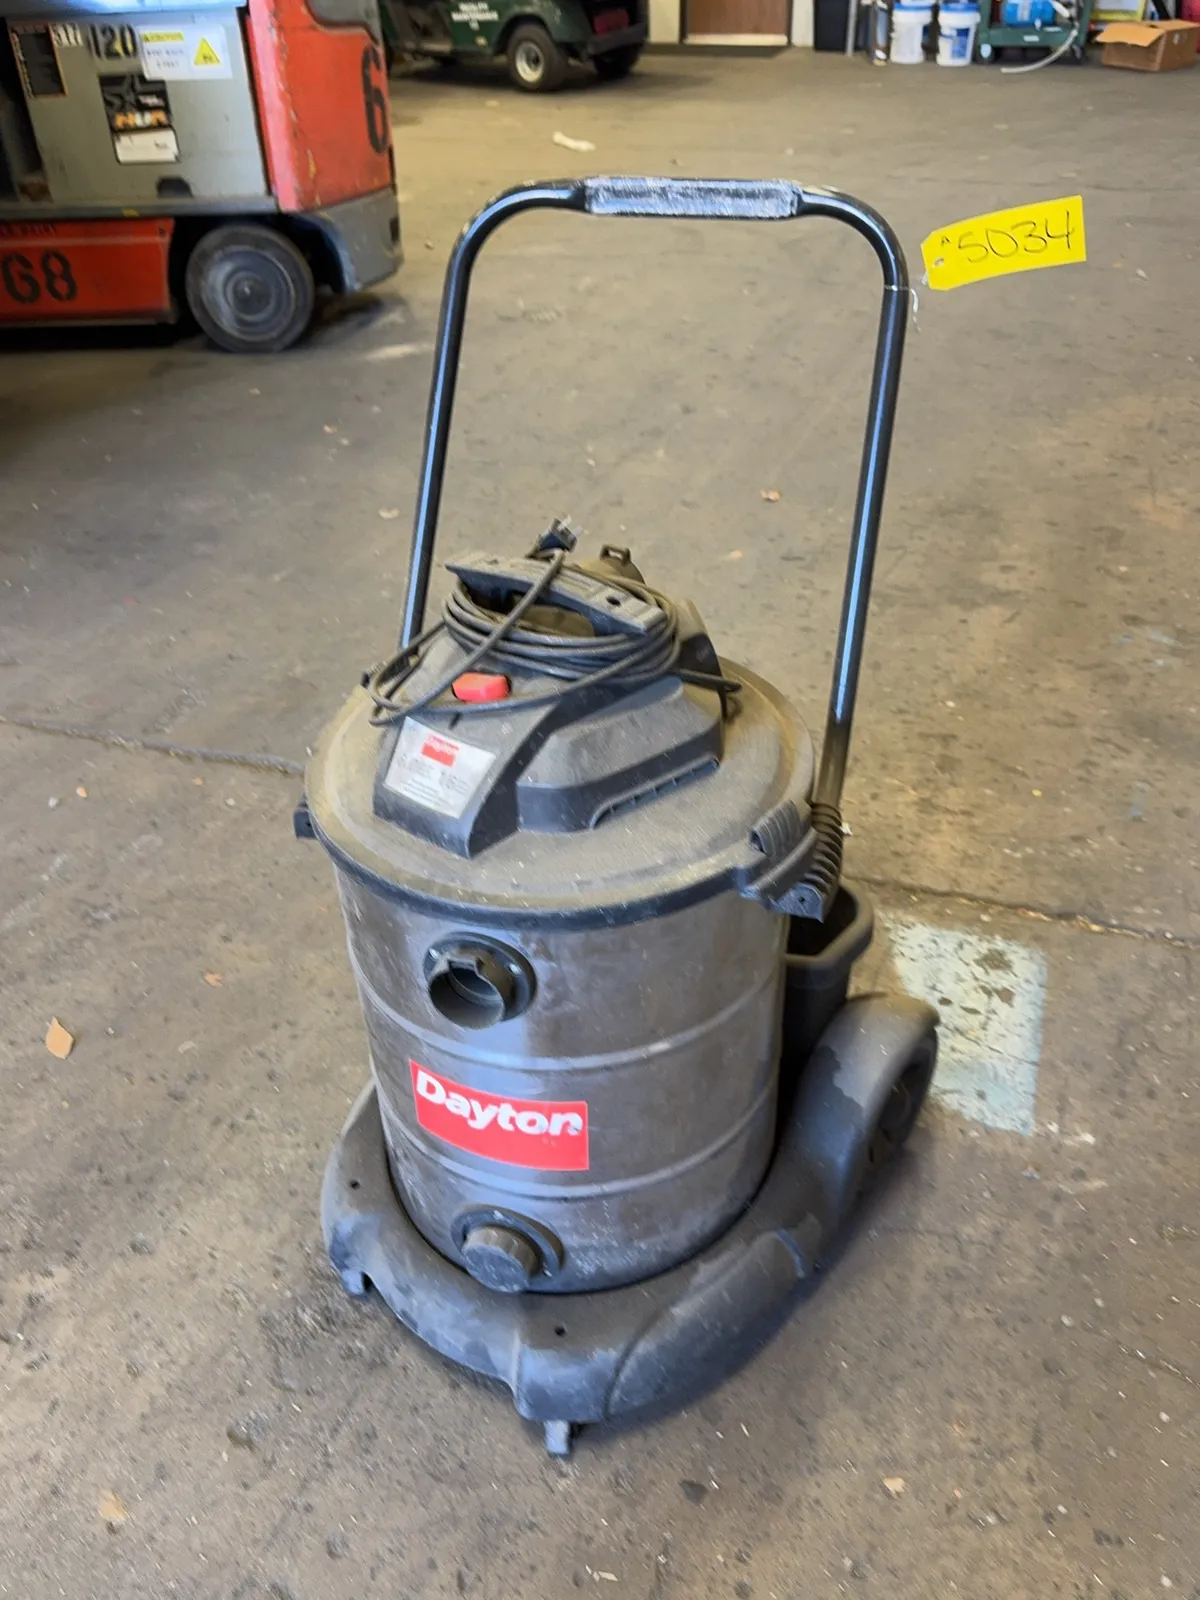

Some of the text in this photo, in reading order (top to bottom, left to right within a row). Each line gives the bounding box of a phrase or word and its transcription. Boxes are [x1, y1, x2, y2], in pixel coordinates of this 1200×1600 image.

[362, 45, 388, 153] 6
[958, 209, 1075, 263] 5034
[416, 1069, 584, 1137] Dayton
